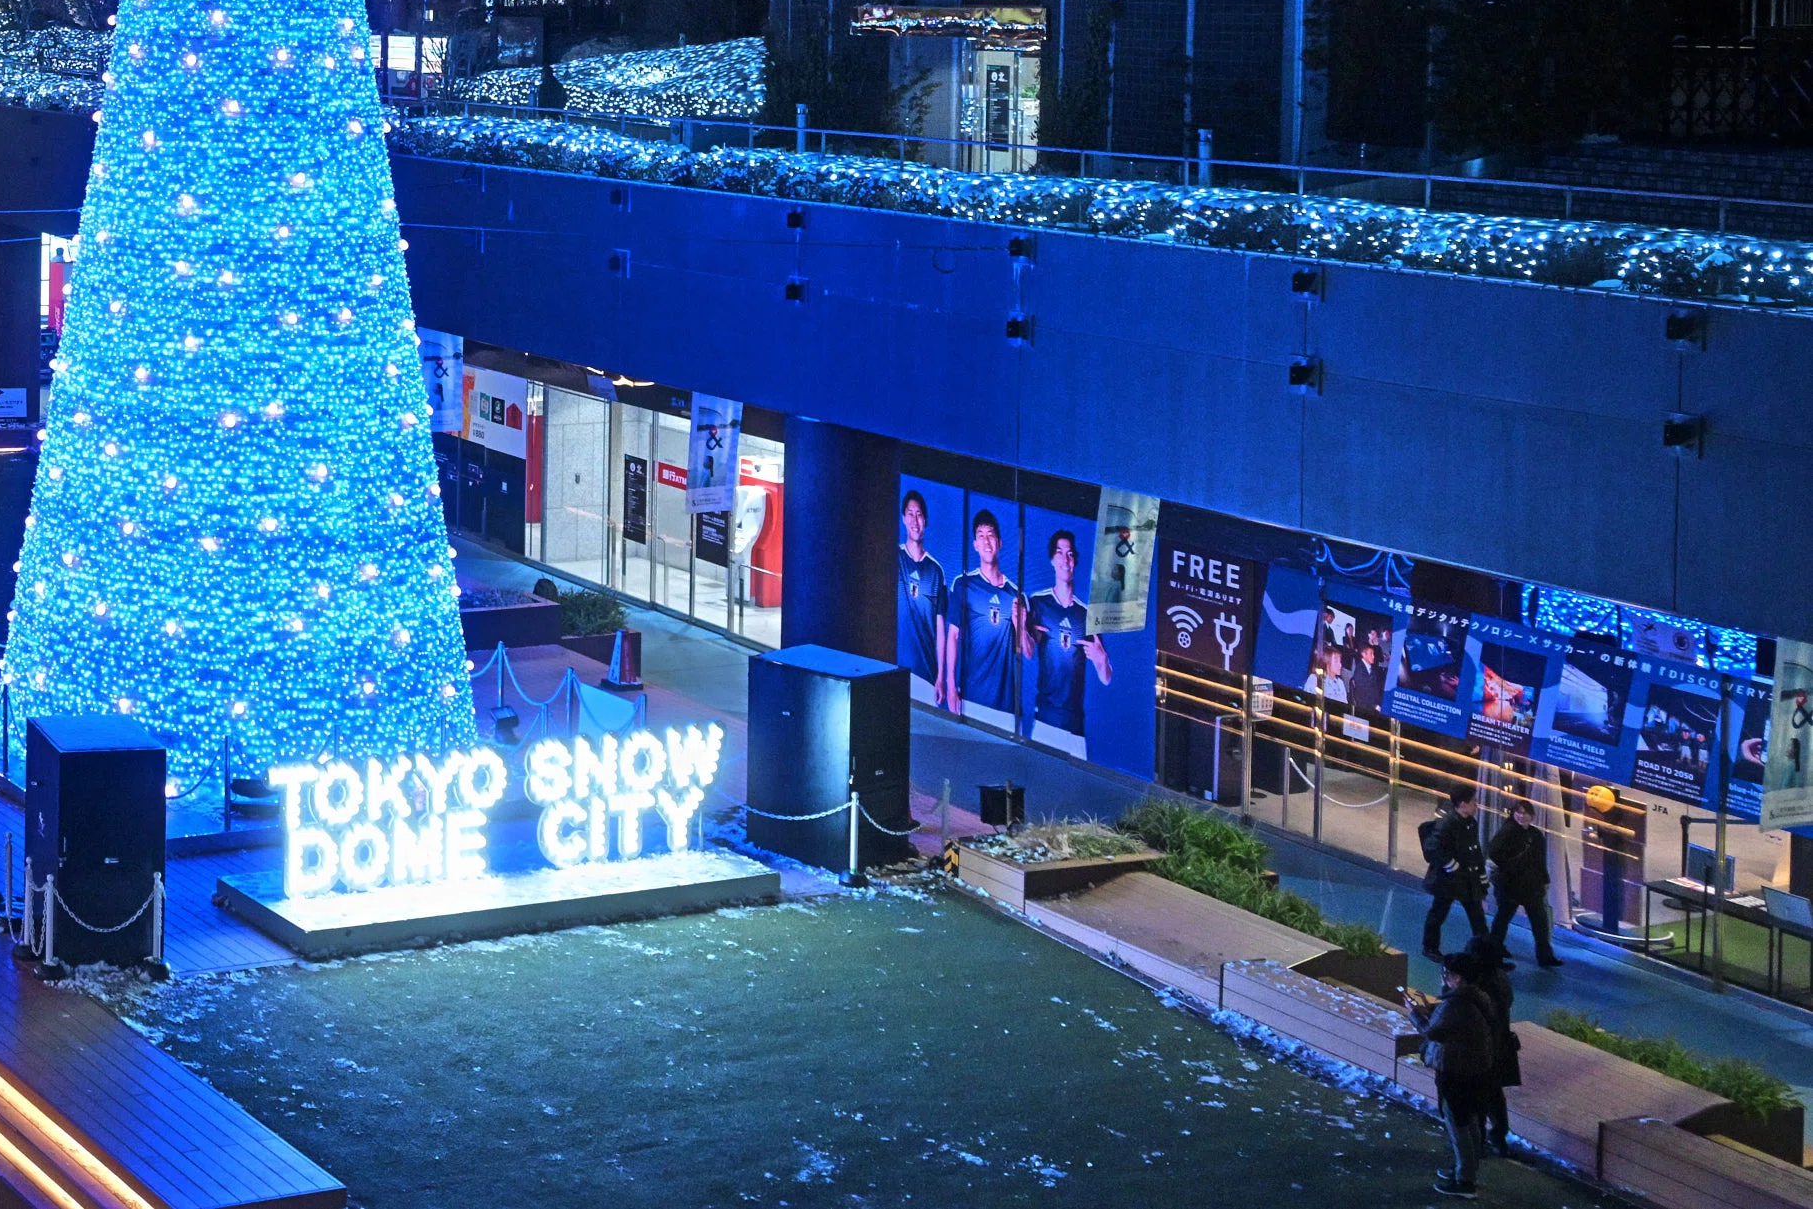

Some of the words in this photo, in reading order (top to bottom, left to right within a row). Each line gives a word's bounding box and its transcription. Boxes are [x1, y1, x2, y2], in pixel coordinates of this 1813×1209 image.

[1172, 550, 1240, 589] FREE
[1394, 691, 1420, 706] DIGITAL
[1421, 698, 1462, 716] COLLECTION
[1472, 713, 1496, 726] DREAM
[1550, 735, 1582, 750] VIRTUAL
[1582, 743, 1605, 756] FIELD
[265, 745, 508, 828] TOKYO
[524, 720, 725, 805] SNOW
[1638, 759, 1660, 772] ROAD
[1661, 765, 1673, 775] TO
[1673, 769, 1694, 781] 2050
[1652, 803, 1669, 816] JFA
[284, 810, 487, 898] DOME
[537, 787, 705, 867] CITY
